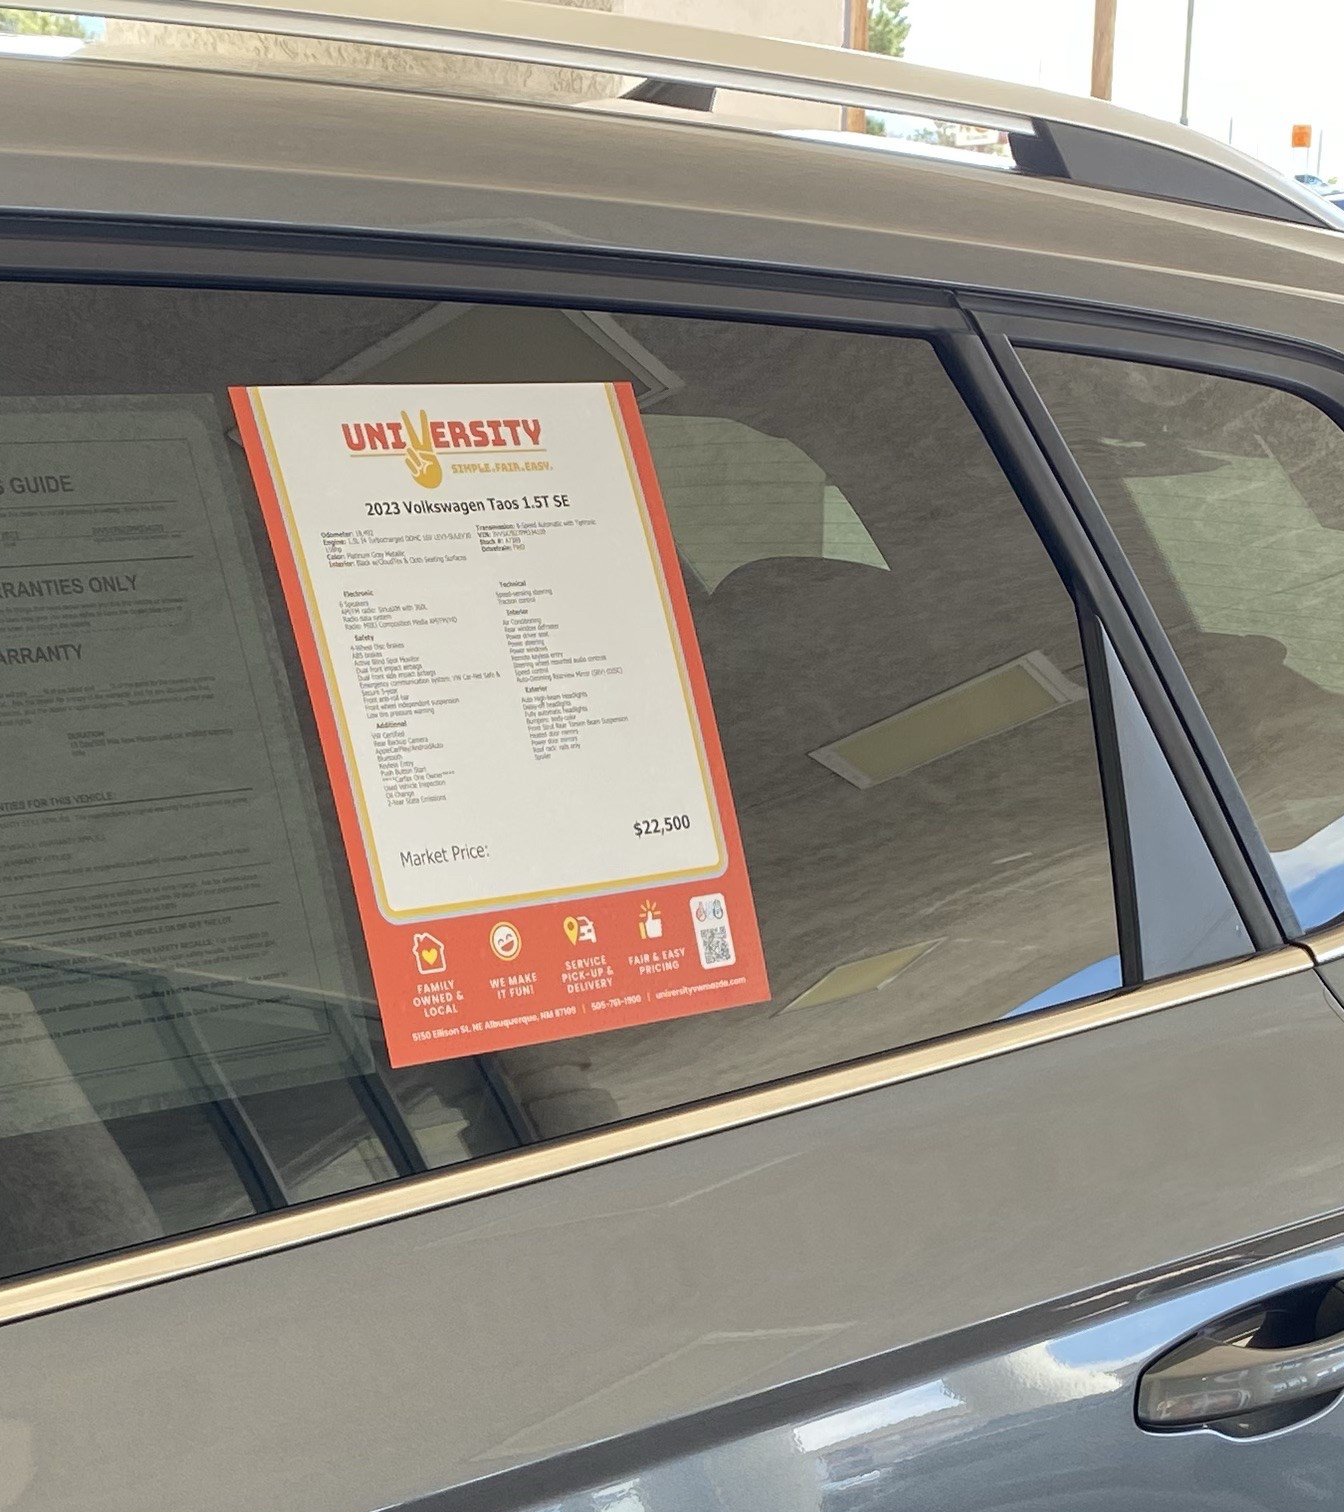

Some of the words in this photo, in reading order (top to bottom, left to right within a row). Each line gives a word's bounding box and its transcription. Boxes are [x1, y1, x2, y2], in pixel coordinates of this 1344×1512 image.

[10, 474, 74, 494] GUIDE
[365, 502, 400, 516] 2023
[403, 499, 485, 515] Volkswagen
[487, 497, 519, 511] Taos
[524, 496, 549, 510] 1.5T
[554, 495, 570, 508] SE
[89, 575, 137, 593] ONLY
[27, 798, 47, 808] FOR
[49, 795, 72, 806] THIS
[74, 791, 114, 803] VEHICLE:
[634, 814, 691, 838] $22,500
[400, 849, 449, 868] Market
[451, 844, 490, 863] Price:
[565, 955, 607, 970] SERVICE
[628, 953, 651, 966] FAIR
[662, 947, 686, 961] EASY
[561, 968, 602, 983] PICK-UP
[605, 966, 614, 976] &
[639, 960, 680, 976] PRICING
[417, 980, 455, 996] FAMILY
[490, 977, 505, 990] WE
[508, 972, 537, 988] MAKE
[567, 977, 613, 994] DELIVERY
[413, 992, 452, 1007] OWNED
[456, 991, 464, 1001] &
[497, 987, 506, 999] IT
[509, 984, 535, 998] FUN!
[424, 1004, 459, 1018] LOCAL
[432, 1026, 459, 1040] Ellison
[485, 1012, 539, 1032] Albuquerque,
